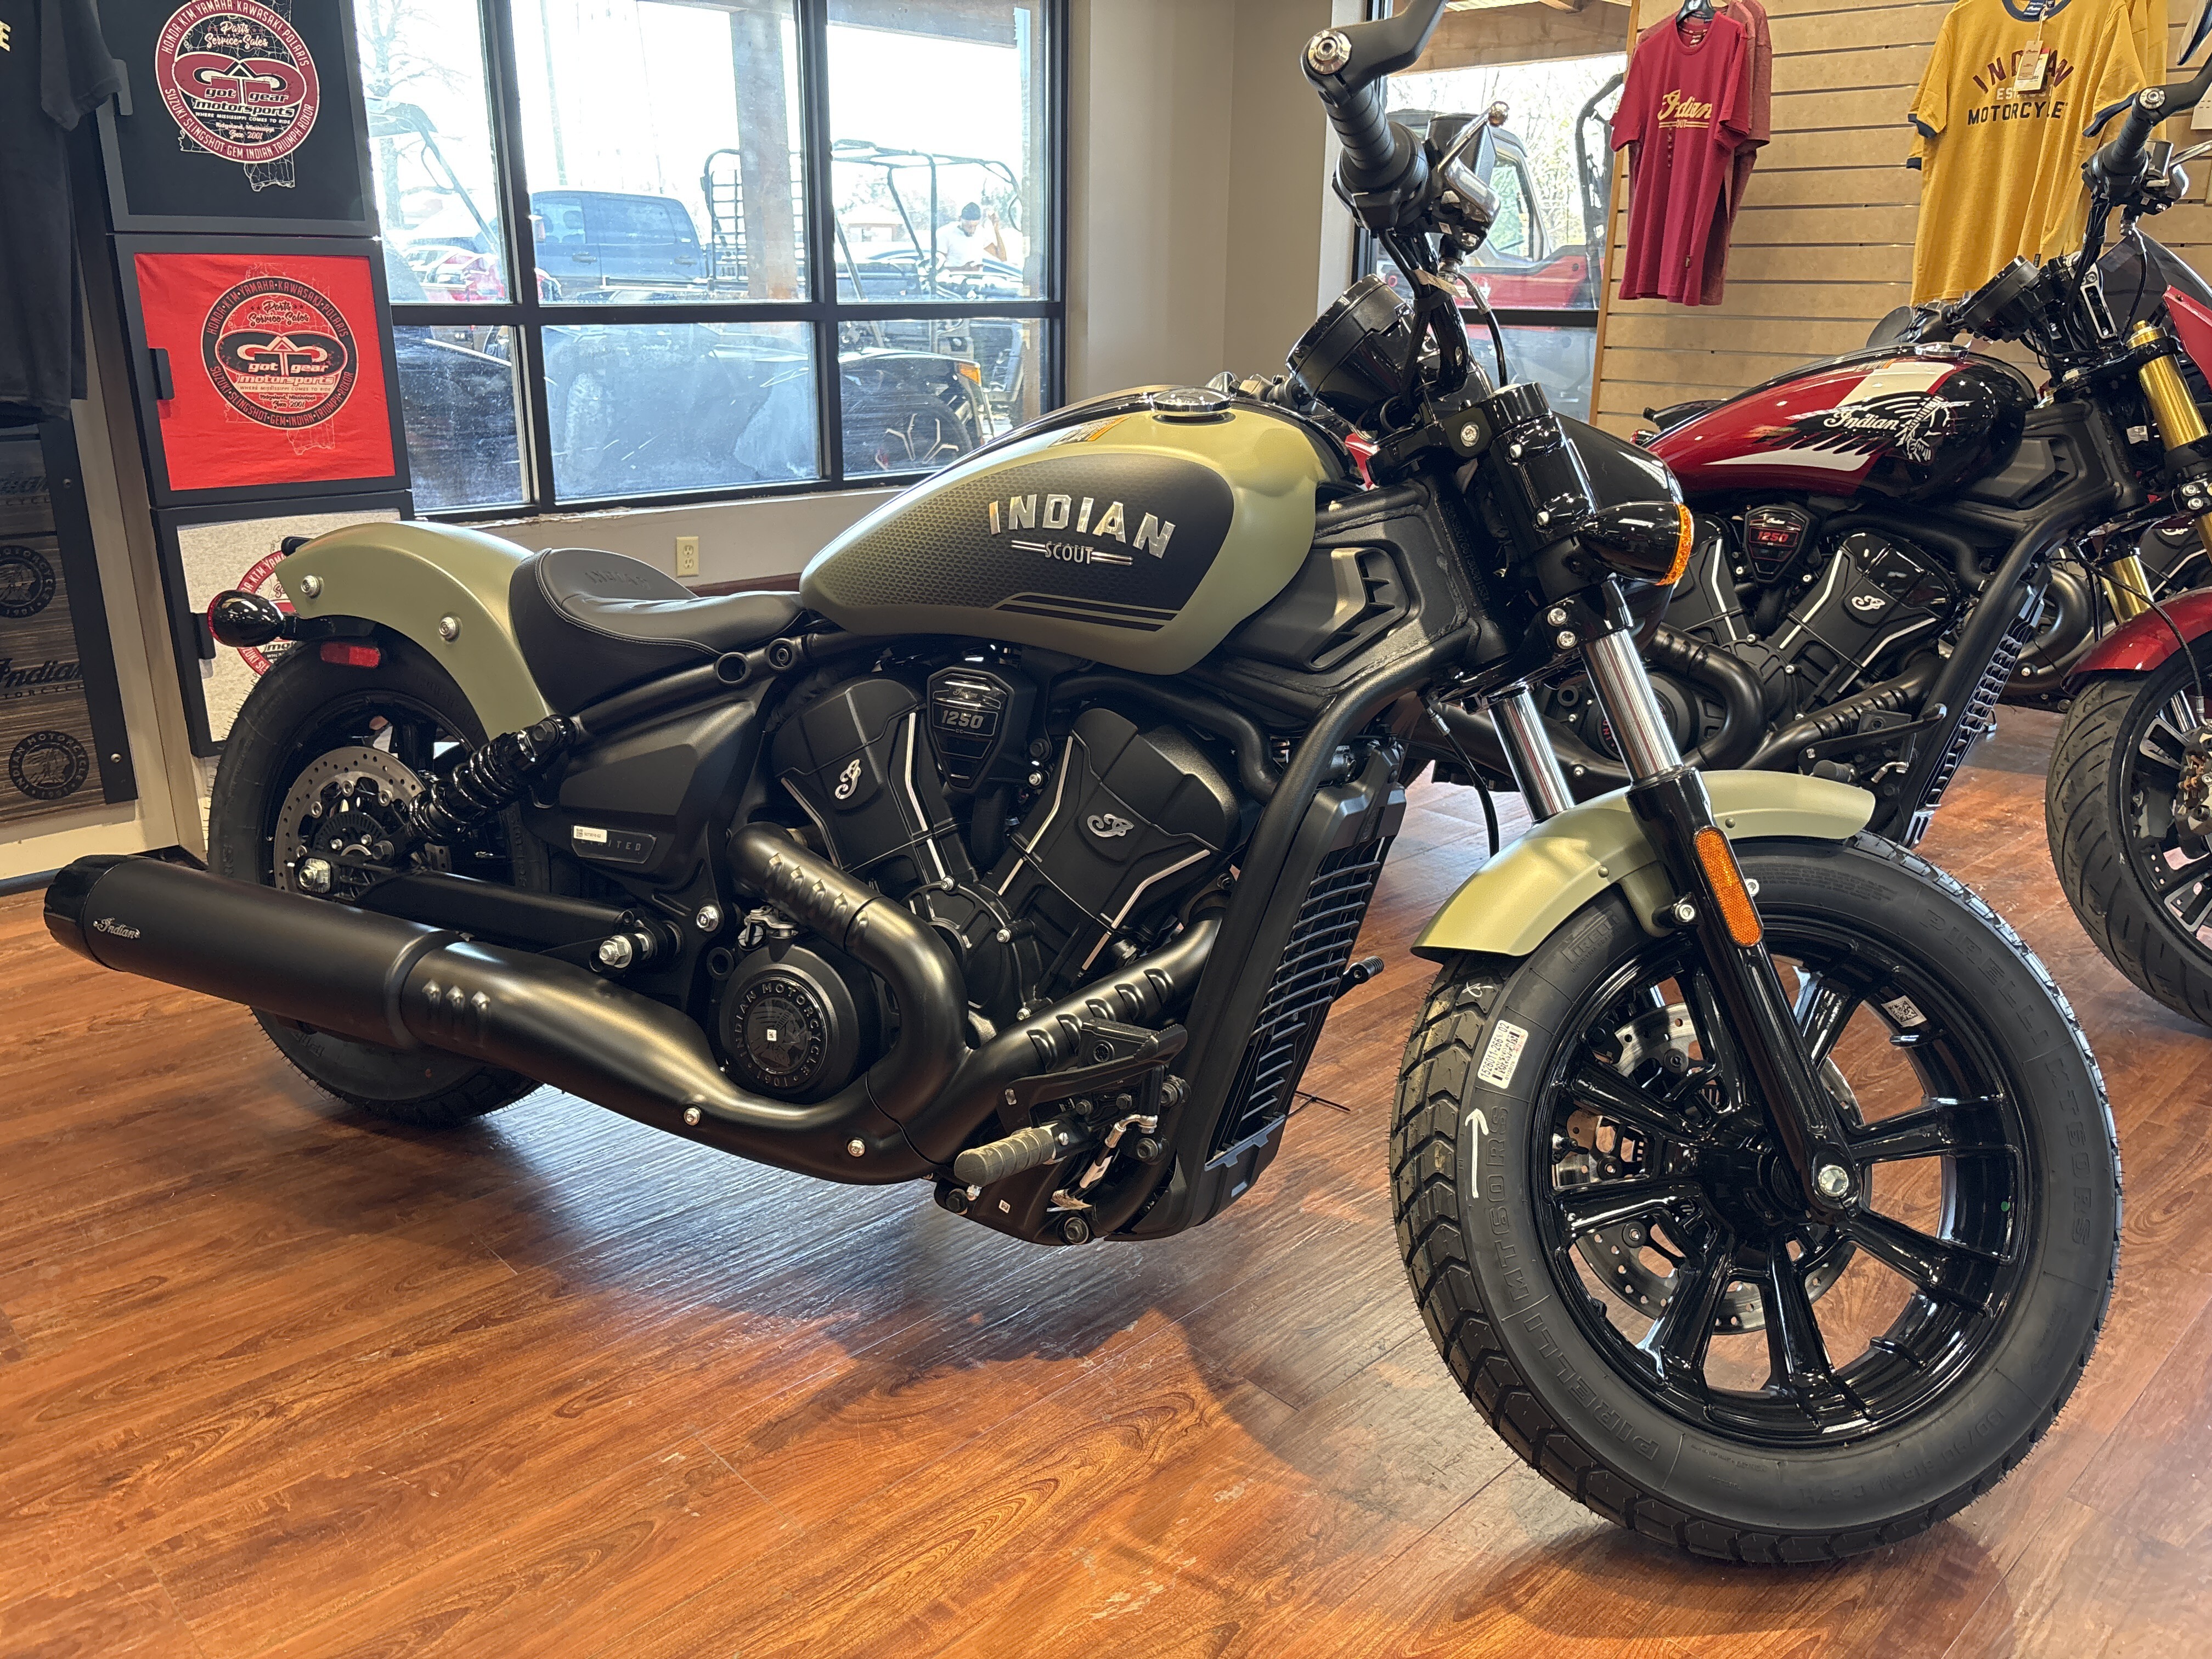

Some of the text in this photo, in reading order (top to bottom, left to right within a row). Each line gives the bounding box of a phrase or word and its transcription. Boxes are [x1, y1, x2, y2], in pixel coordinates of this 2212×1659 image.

[161, 0, 310, 66] HONDA KTM YAMAHA KAWASAKI POLARIS
[219, 21, 250, 35] Parts
[1972, 49, 2074, 94] INDAN
[205, 87, 289, 103] got gear
[193, 99, 295, 117] motorsports
[164, 88, 314, 160] SUZUKI SLINGSHOT GEM INDIAN TRIUMPH ROXOR
[247, 131, 263, 139] 2001
[206, 280, 349, 337] HONDA KTM YAMAHA KAWASAKI POLARIS
[262, 300, 292, 313] Parts
[248, 362, 329, 374] got gear
[239, 374, 335, 386] motorsports
[210, 365, 354, 427] SUZUKI SLINGSHOT GEM INDIAN TRIUMPH ROXOR
[1823, 410, 1900, 431] Indian
[989, 493, 1176, 560] INDIAN
[1757, 531, 1788, 543] 1250
[1045, 541, 1094, 565] SCOUT
[249, 566, 267, 583] KTM
[941, 710, 984, 729] 1250
[95, 917, 139, 939] Indian
[1920, 909, 2049, 1046] PIRELLI
[735, 983, 821, 1076] INDIAN MOTORCYCLE
[1523, 1313, 1660, 1461] PIRELLI
